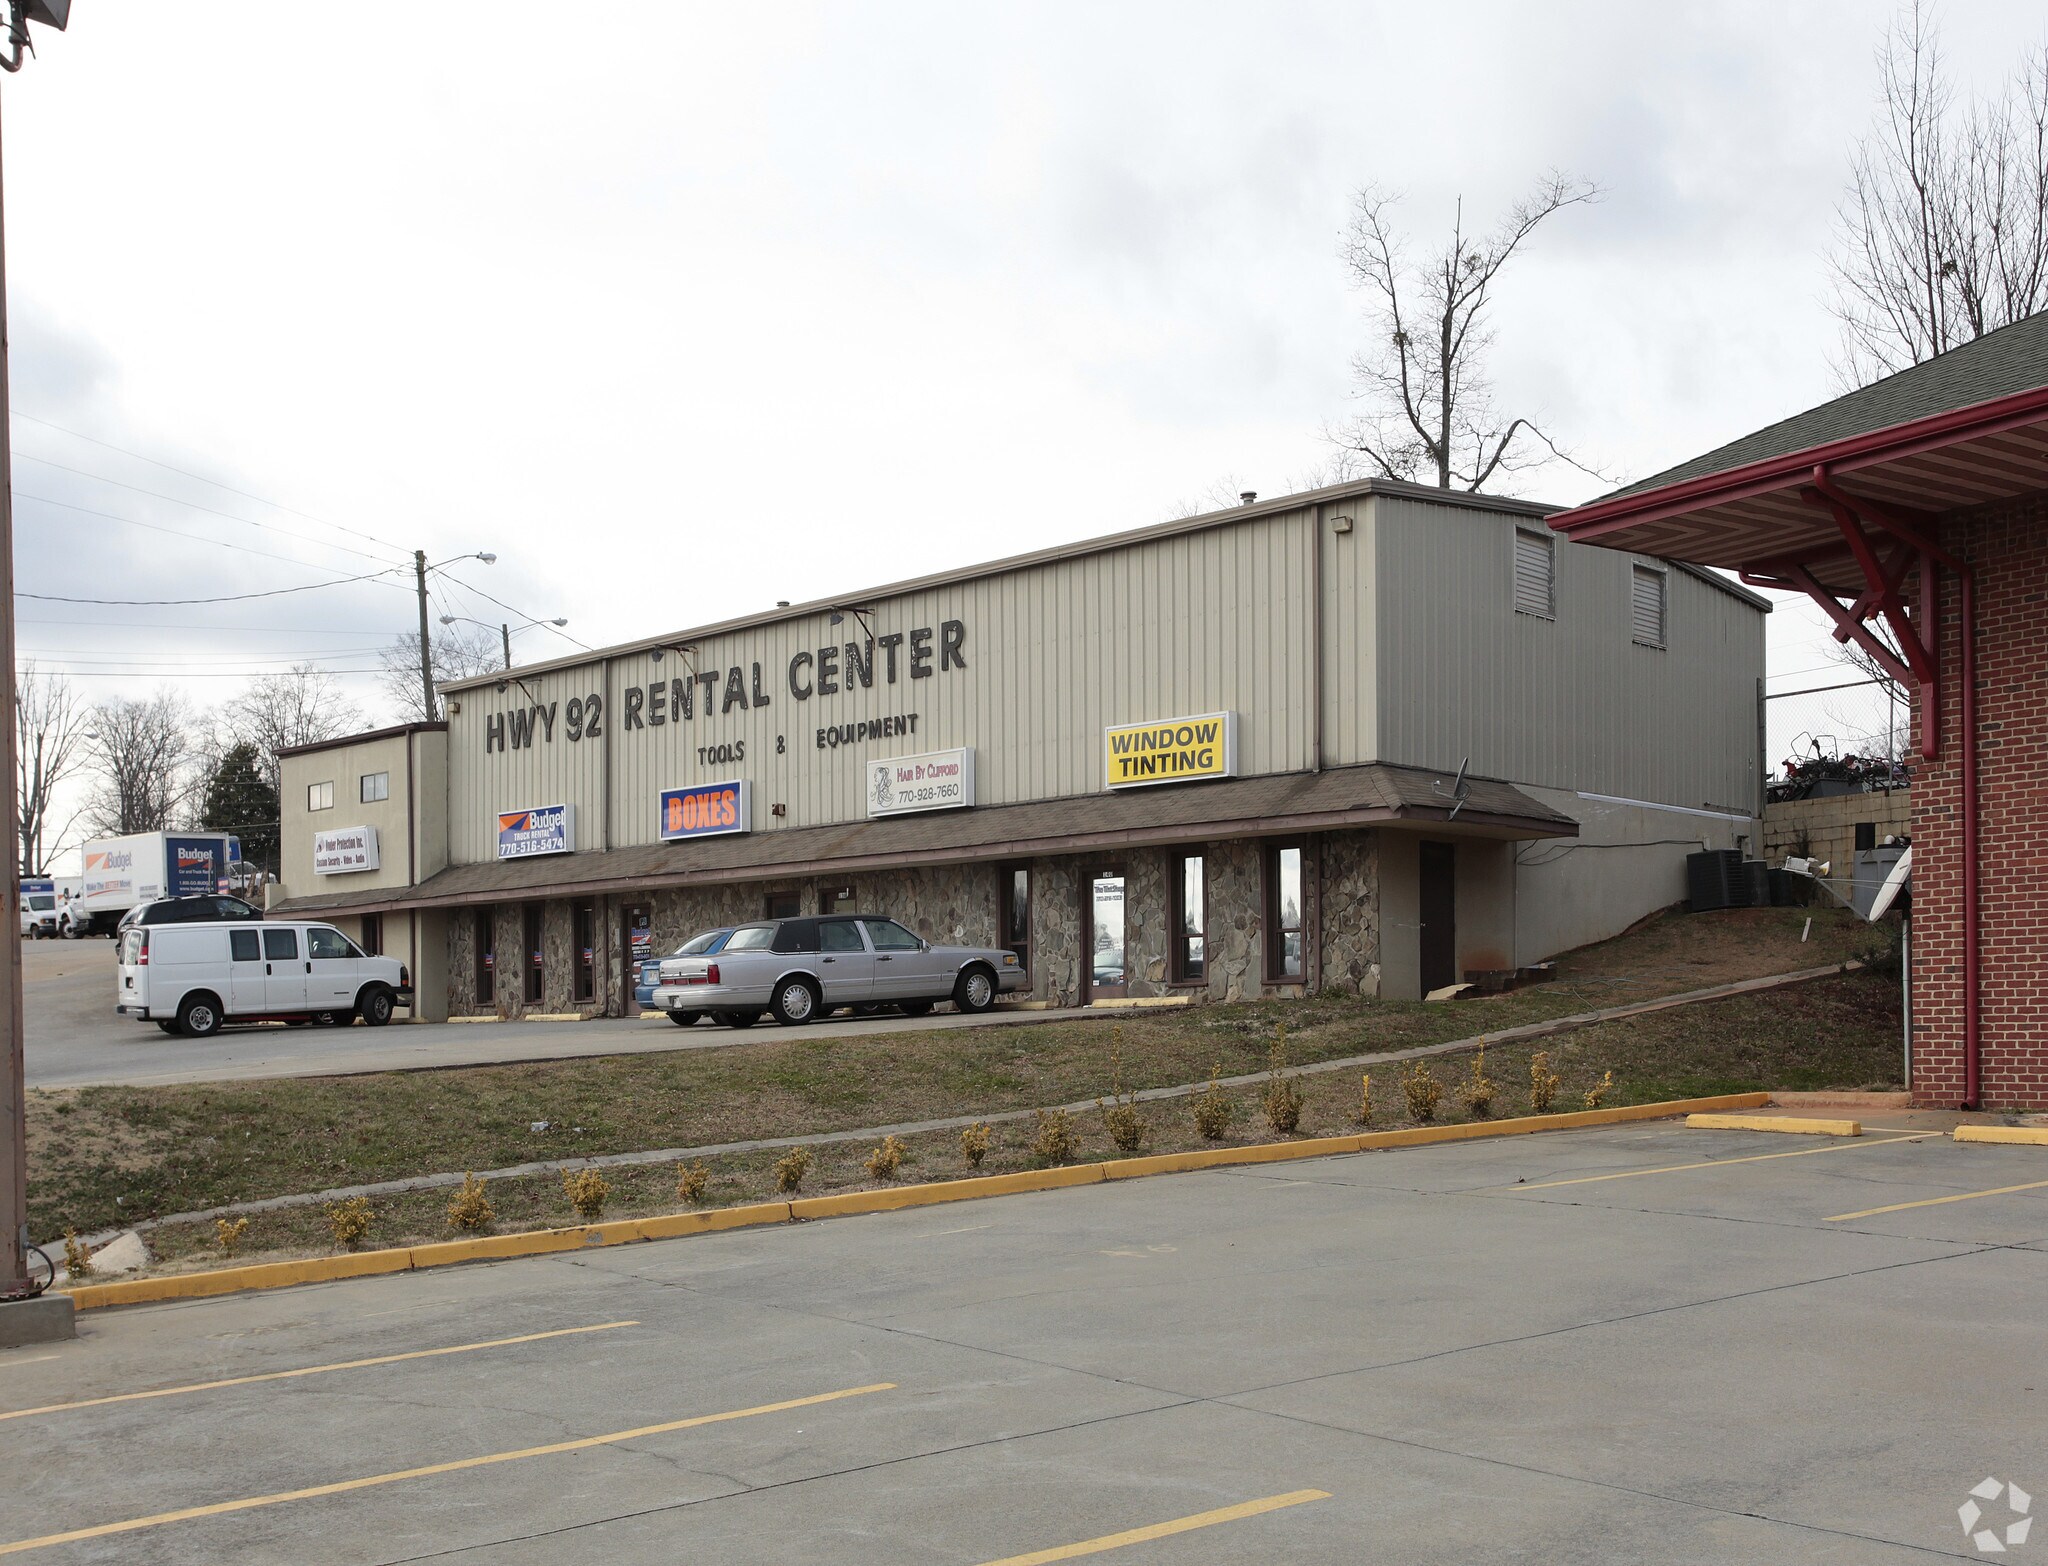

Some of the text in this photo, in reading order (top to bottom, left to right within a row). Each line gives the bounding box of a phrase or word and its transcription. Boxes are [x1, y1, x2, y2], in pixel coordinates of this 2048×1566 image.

[486, 619, 967, 753] HWY 92 RENTAL CENTER
[698, 713, 918, 766] TOOLS & EQUIPMENT
[1111, 722, 1218, 755] WINDOW
[1119, 748, 1213, 777] TINTING
[898, 783, 959, 803] 770-928-7660
[528, 810, 566, 831] Budget
[667, 789, 736, 832] BOXES
[336, 837, 356, 850] Protection
[513, 829, 550, 841] TRUCK RENTAL
[177, 847, 214, 862] Budget
[500, 837, 564, 855] 770-516-5474
[107, 850, 132, 872] Budget
